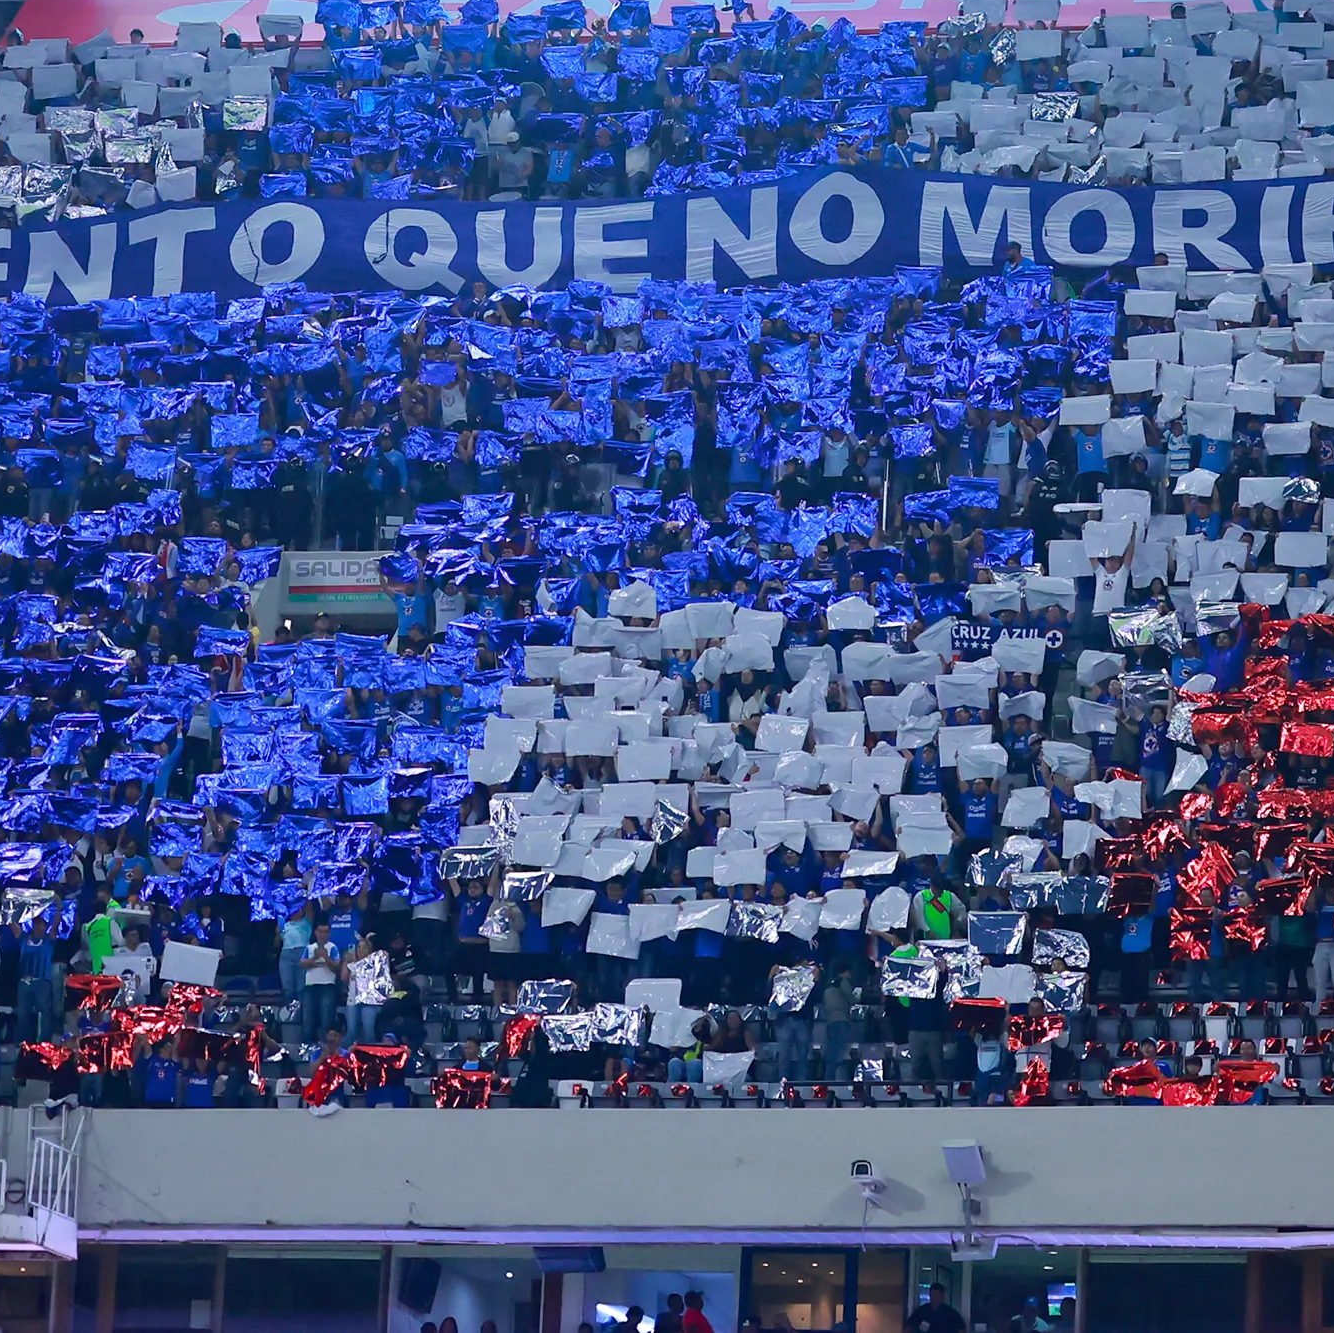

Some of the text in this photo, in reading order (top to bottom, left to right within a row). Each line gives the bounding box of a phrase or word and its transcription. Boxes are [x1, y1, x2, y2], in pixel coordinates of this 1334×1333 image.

[364, 201, 654, 295] QUE
[685, 170, 884, 282] NO
[296, 560, 378, 577] SALIDA
[951, 625, 991, 640] CRUZ
